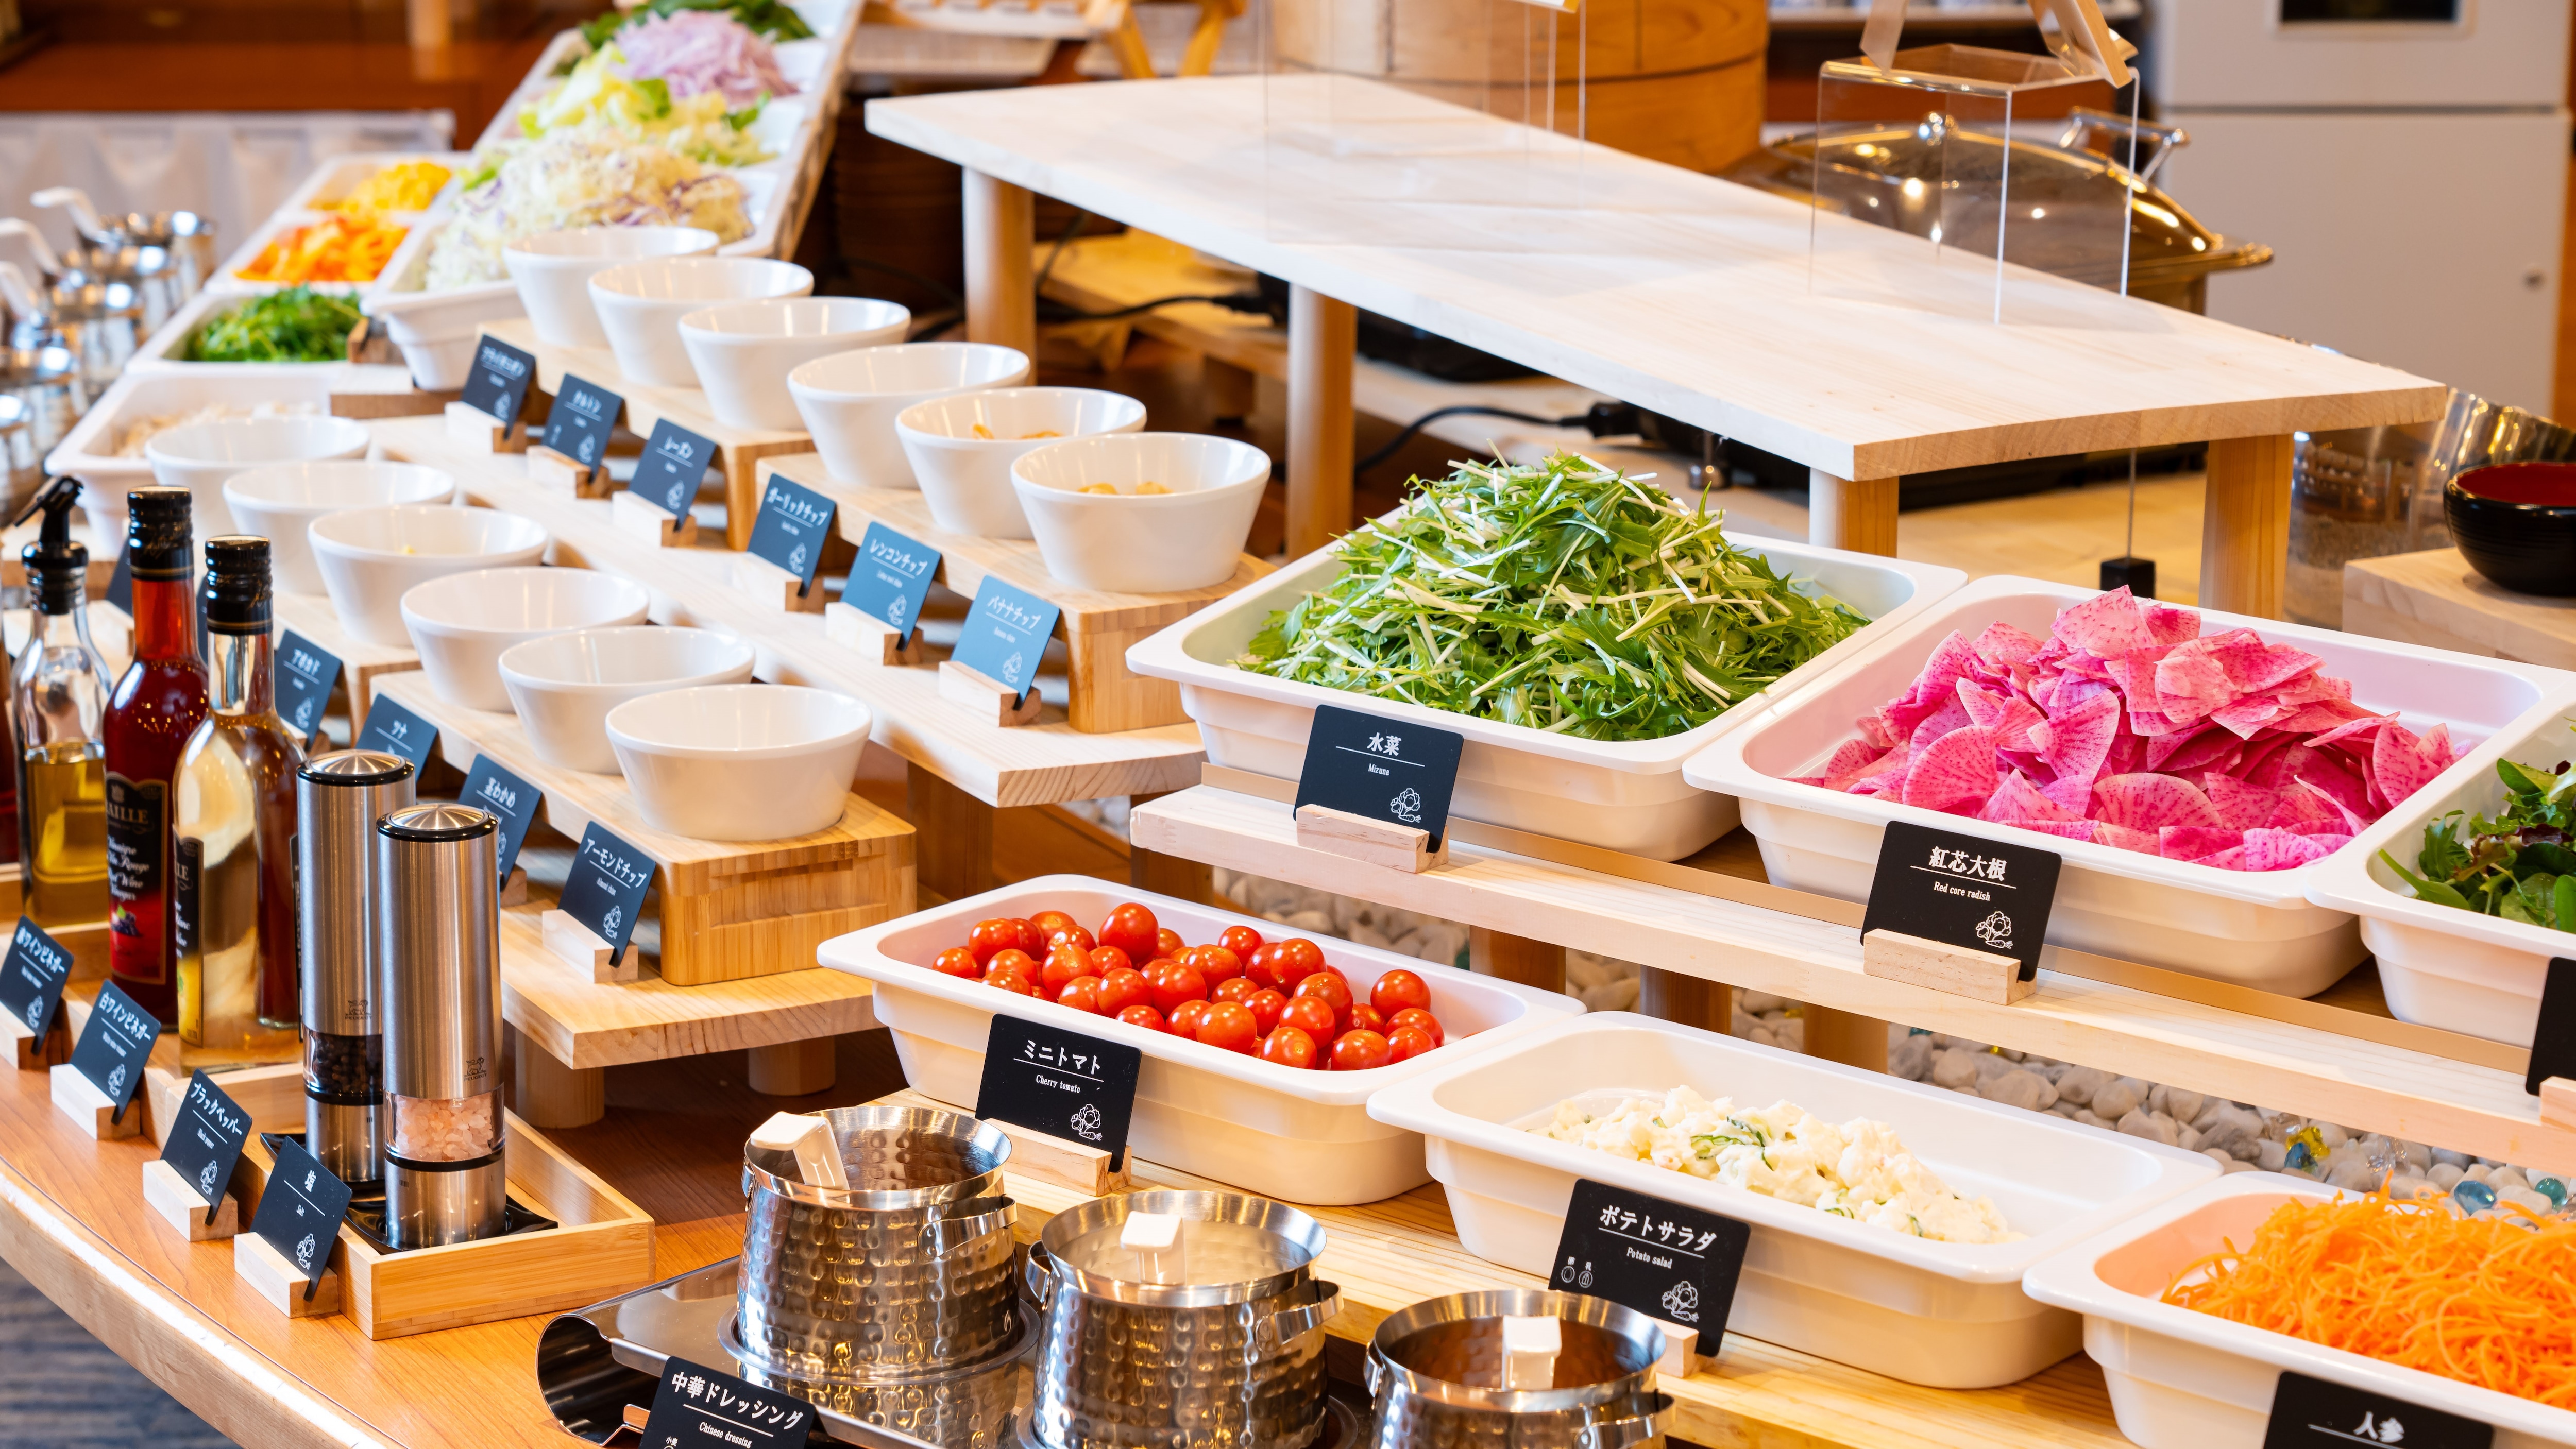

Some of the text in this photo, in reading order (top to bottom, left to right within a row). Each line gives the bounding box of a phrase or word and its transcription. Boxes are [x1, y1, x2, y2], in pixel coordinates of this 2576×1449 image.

[767, 487, 828, 526] ガーリックチップ
[870, 538, 928, 576] レンコンチップ
[987, 595, 1041, 629] バナナチップ
[392, 720, 407, 740] ツナ
[1367, 732, 1402, 756] 水菜
[1368, 763, 1390, 776] Mizuna
[107, 802, 148, 824] AILLE
[584, 838, 647, 888] アーモンドチップ
[1928, 846, 2008, 882] 紅芯大根
[1934, 881, 1991, 901] Red core radish
[99, 991, 151, 1041] 白ワインビネガー
[1024, 1039, 1100, 1075] ミニトマト
[463, 1073, 487, 1082] PEUGEOT
[1036, 1074, 1081, 1094] Cherry tomato
[191, 1082, 242, 1135] ブラックペッパー
[304, 1169, 317, 1192] 塩
[296, 1204, 305, 1217] Salt
[1600, 1205, 1717, 1251] ポテトサラダ
[1626, 1247, 1673, 1269] Potato salad
[671, 1371, 804, 1429] 中華ドレッシング
[699, 1422, 752, 1448] Chinese dressing
